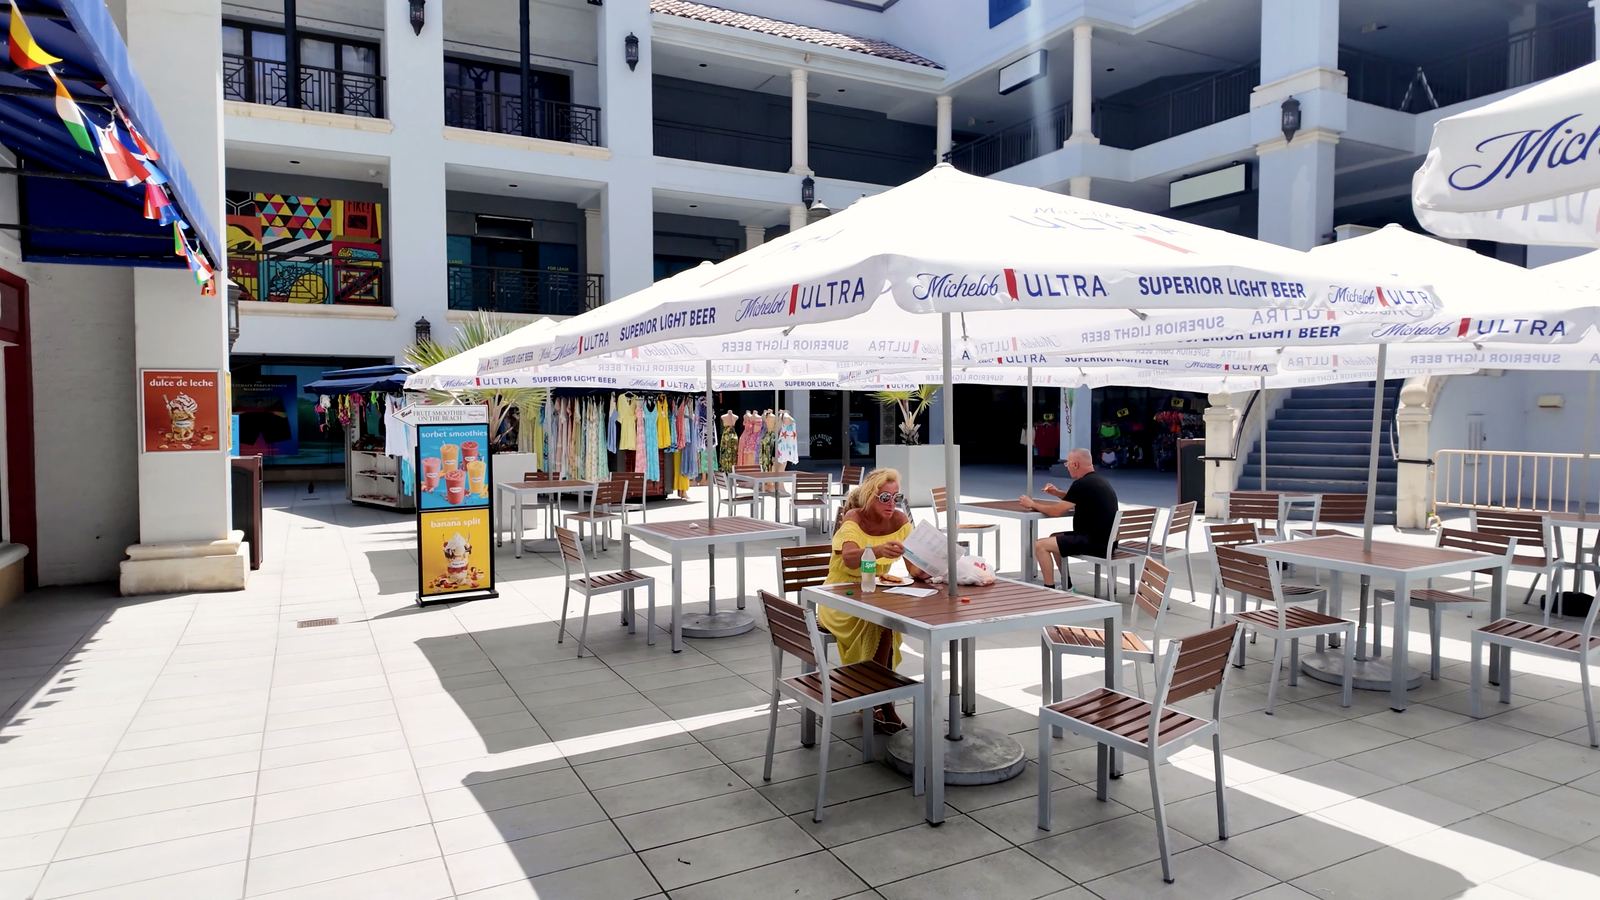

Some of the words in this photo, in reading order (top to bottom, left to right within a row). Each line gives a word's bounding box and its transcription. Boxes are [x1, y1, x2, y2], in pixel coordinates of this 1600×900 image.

[912, 272, 998, 300] Michelob
[1023, 273, 1108, 297] ULTRA
[1138, 275, 1223, 296] SUPERIOR
[1226, 278, 1267, 298] LIGHT
[1270, 281, 1306, 298] BEER
[1328, 284, 1375, 305] Michelob
[620, 320, 657, 342] SUPERIOR
[660, 310, 688, 331] LIGHT
[689, 306, 716, 326] BEER
[735, 290, 787, 322] Michelob
[800, 276, 865, 310] ULTRA
[1298, 326, 1340, 338] BEER
[1372, 321, 1456, 338] Michelob
[1477, 320, 1566, 336] ULTRA
[584, 332, 610, 352] ULTRA
[482, 376, 518, 386] ULTRA
[532, 376, 573, 384] SUPERIOR
[574, 375, 596, 384] LIGHT
[598, 376, 618, 384] BEER
[666, 382, 695, 390] ULTRA
[748, 380, 774, 388] ULTRA
[430, 520, 461, 528] banana
[464, 517, 480, 528] split
